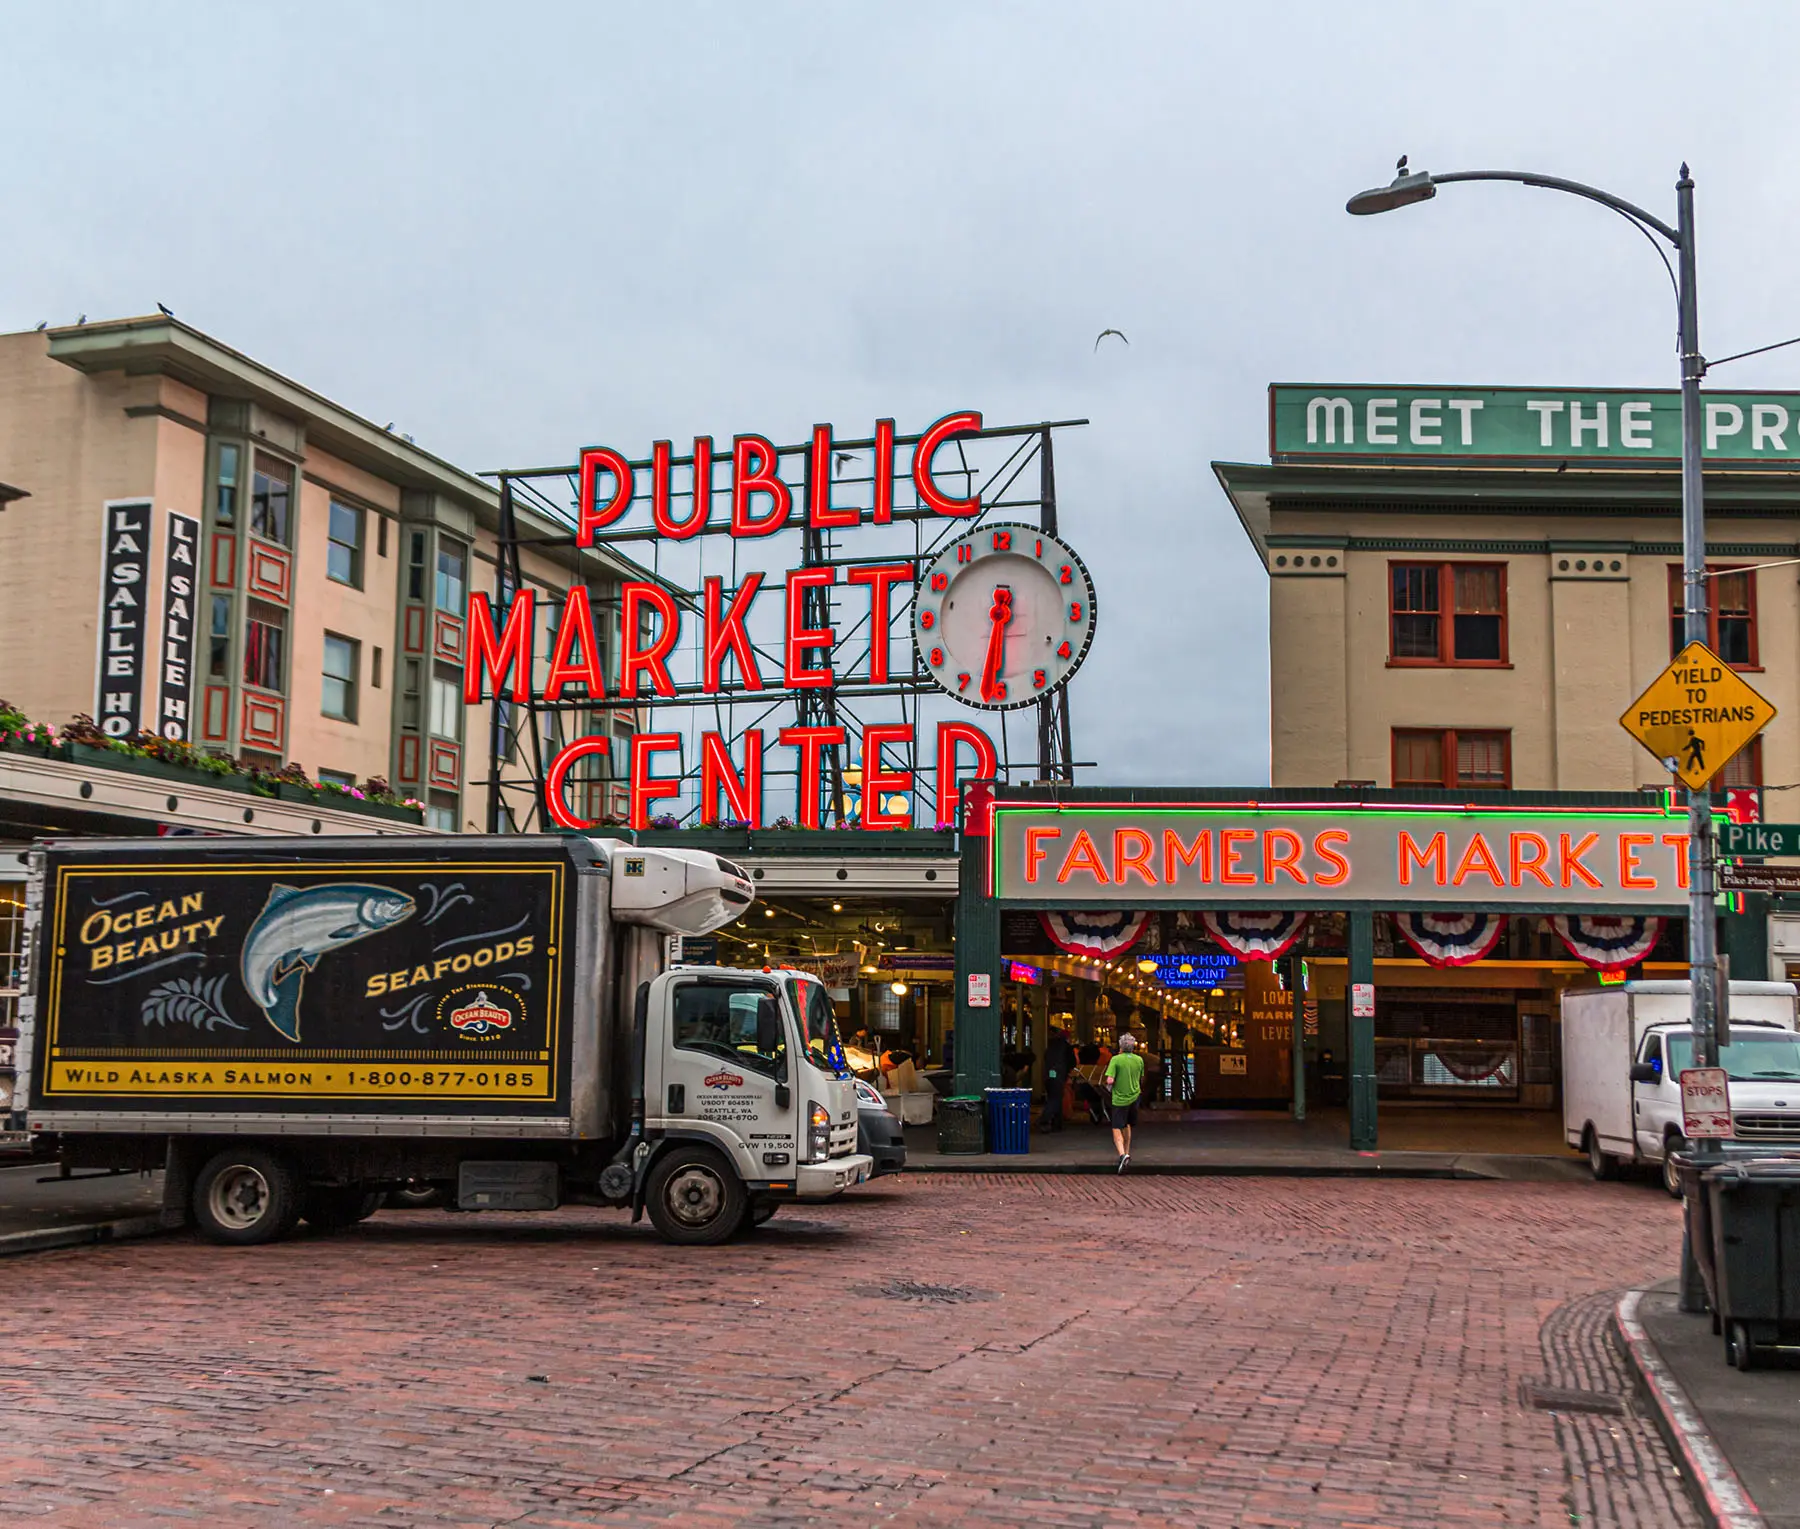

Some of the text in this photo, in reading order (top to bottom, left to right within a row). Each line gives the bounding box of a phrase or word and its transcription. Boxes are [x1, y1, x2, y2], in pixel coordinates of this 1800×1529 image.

[1306, 397, 1800, 451] MEET THE PR
[576, 410, 984, 548] PUBLIC
[111, 511, 142, 554] LA
[171, 518, 193, 566] LA
[993, 532, 1011, 550] 12
[958, 544, 972, 563] 11
[1035, 539, 1042, 558] 1
[931, 573, 948, 591] 10
[1060, 565, 1072, 584] 2
[107, 562, 142, 677] SALLE
[921, 611, 934, 629] 9
[1069, 602, 1081, 622] 3
[165, 575, 192, 687] SALLE
[464, 562, 915, 705] MARKET
[930, 648, 943, 667] 8
[1057, 641, 1071, 660] 4
[958, 673, 971, 691] 7
[1033, 670, 1046, 688] 5
[1672, 667, 1722, 684] YIELD
[993, 682, 1006, 700] 6
[1686, 688, 1706, 703] TO
[1640, 706, 1755, 726] PEDESTRIANS
[545, 721, 998, 830] CENTER
[1729, 826, 1783, 851] Pike
[1024, 827, 1691, 889] FARMERS MARKET
[1724, 876, 1746, 885] Pike
[1748, 877, 1775, 886] Place
[80, 891, 204, 945] OCEAN
[90, 914, 225, 972] BEAUTY
[365, 935, 534, 999] SEAFOODS
[1156, 967, 1227, 979] VIEWPOINT
[455, 1009, 507, 1023] OCEAN BEAUTY
[1262, 1026, 1294, 1041] LEVE
[66, 1069, 533, 1087] WILD ALASKA SALMON 1-800-877-0185
[1686, 1086, 1723, 1097] STOPS
